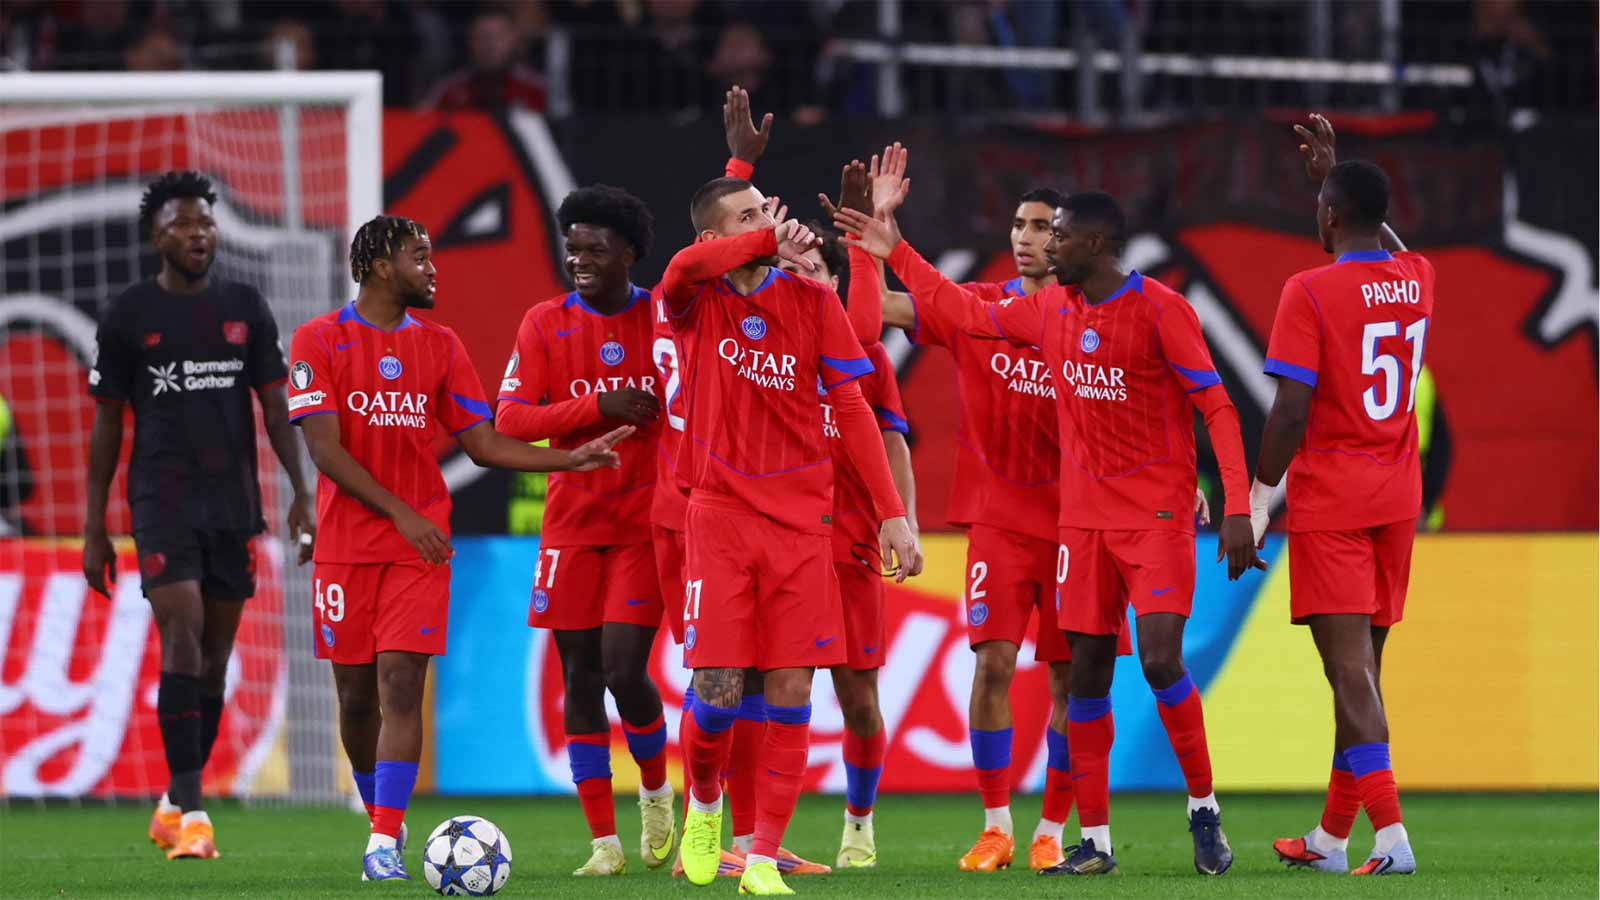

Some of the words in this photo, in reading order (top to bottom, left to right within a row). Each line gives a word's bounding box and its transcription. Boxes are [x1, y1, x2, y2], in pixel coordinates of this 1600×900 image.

[1361, 280, 1420, 308] PACHO
[990, 352, 1052, 383] QATA
[1063, 359, 1126, 387] QATAR
[1361, 316, 1429, 421] 51
[347, 390, 428, 416] QATAR
[1008, 378, 1057, 400] AIRWA
[1074, 384, 1127, 401] AIRWAYS
[368, 413, 426, 429] AIRWAYS
[534, 548, 561, 589] 47
[970, 561, 988, 600] 2
[315, 578, 345, 622] 49
[683, 578, 703, 621] 21
